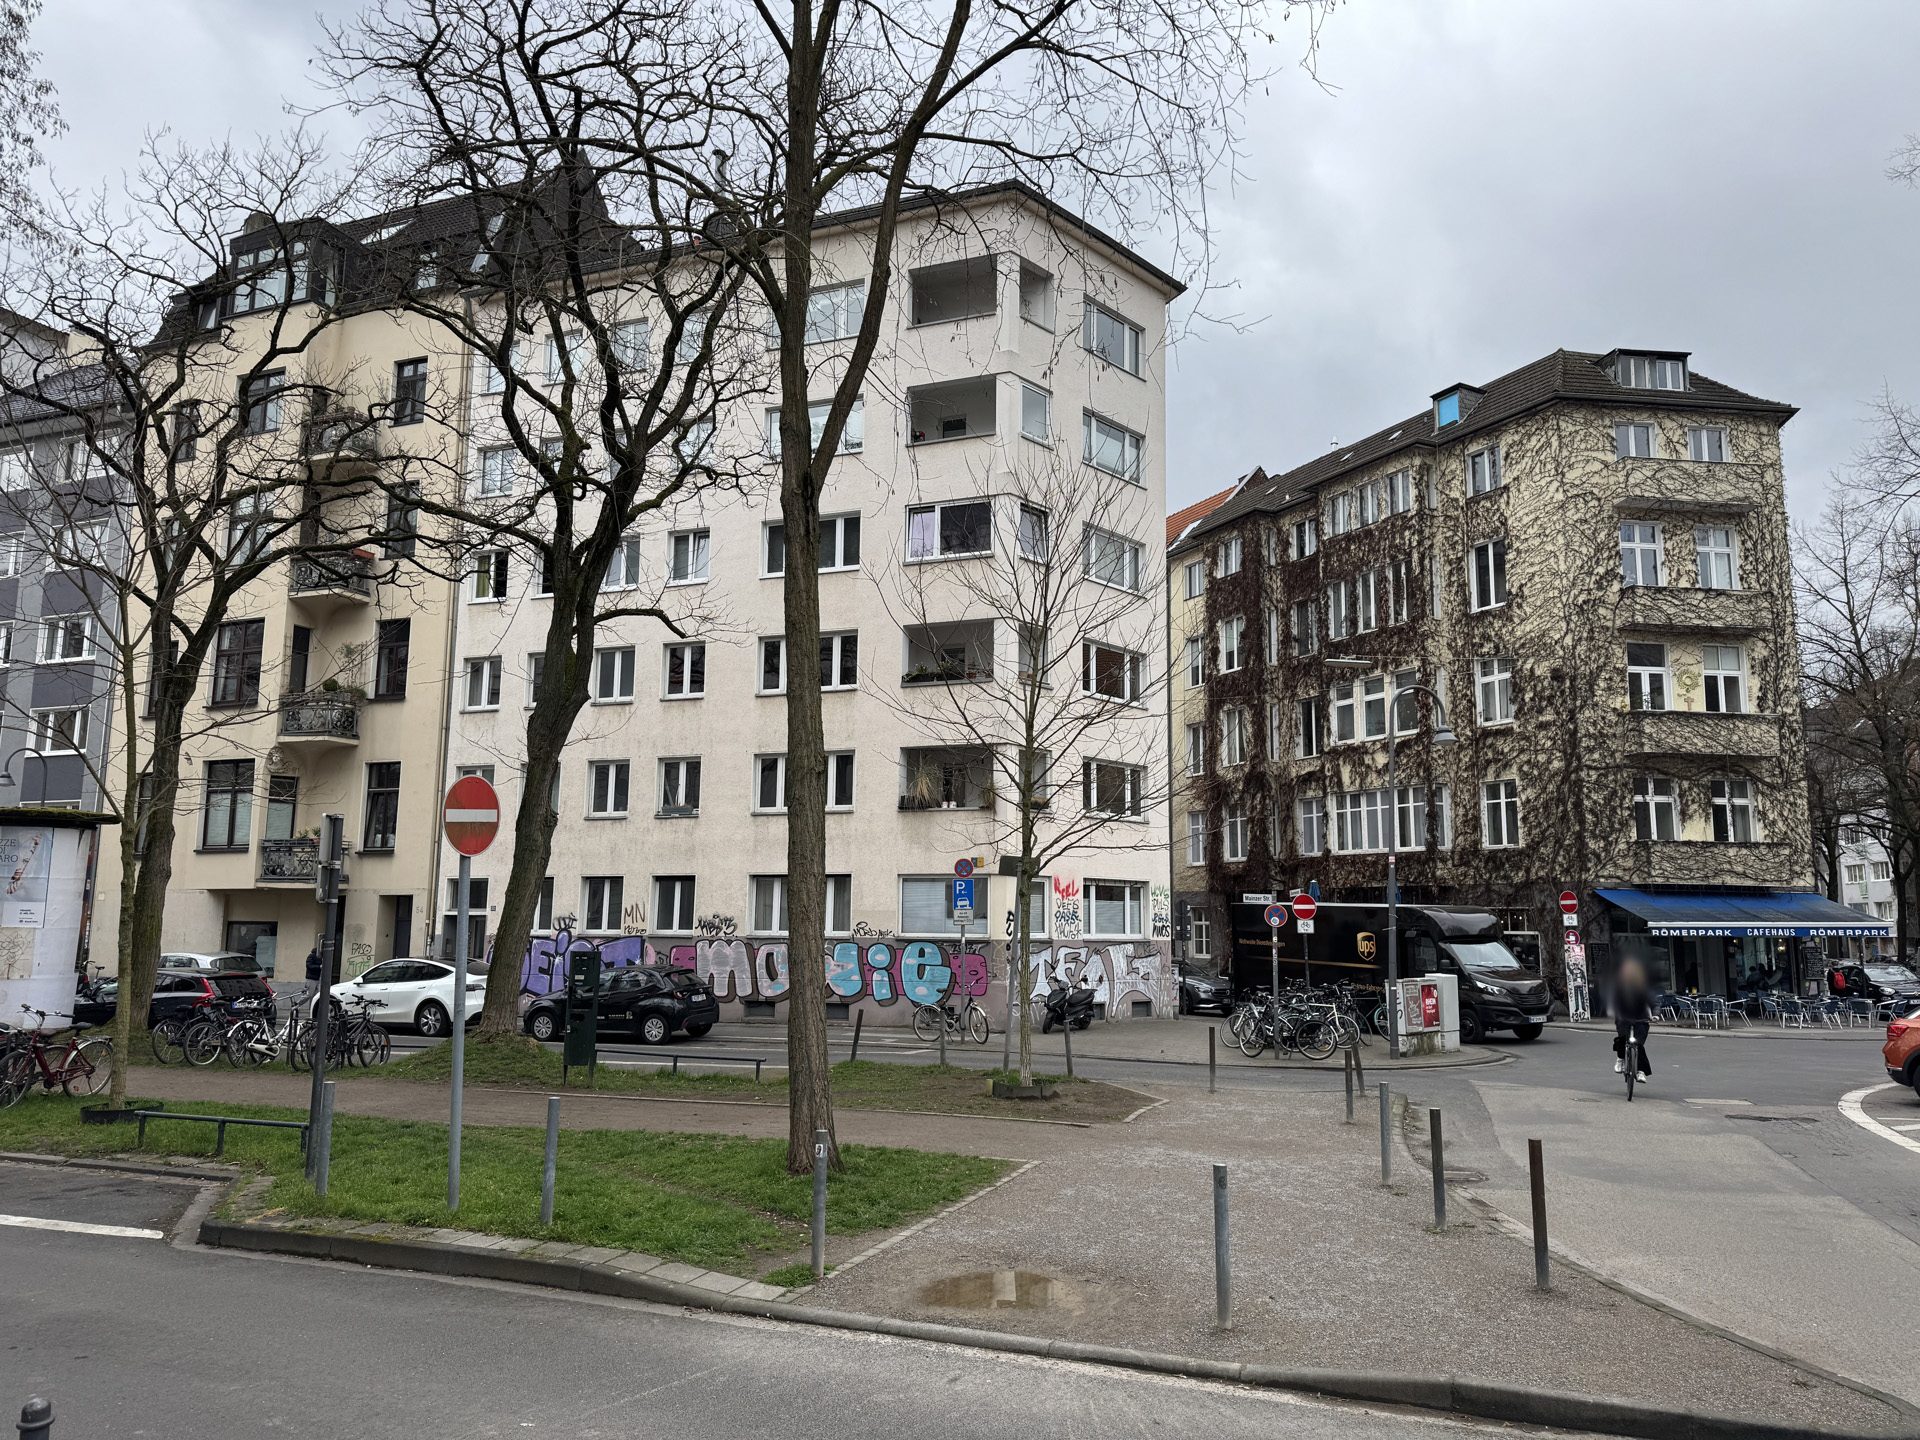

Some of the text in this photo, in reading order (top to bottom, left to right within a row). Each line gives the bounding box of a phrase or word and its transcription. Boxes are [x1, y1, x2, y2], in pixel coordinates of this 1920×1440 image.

[956, 881, 966, 894] P
[1651, 928, 1888, 937] RÖMERPARK CAFEHAUS RÖMERPARK
